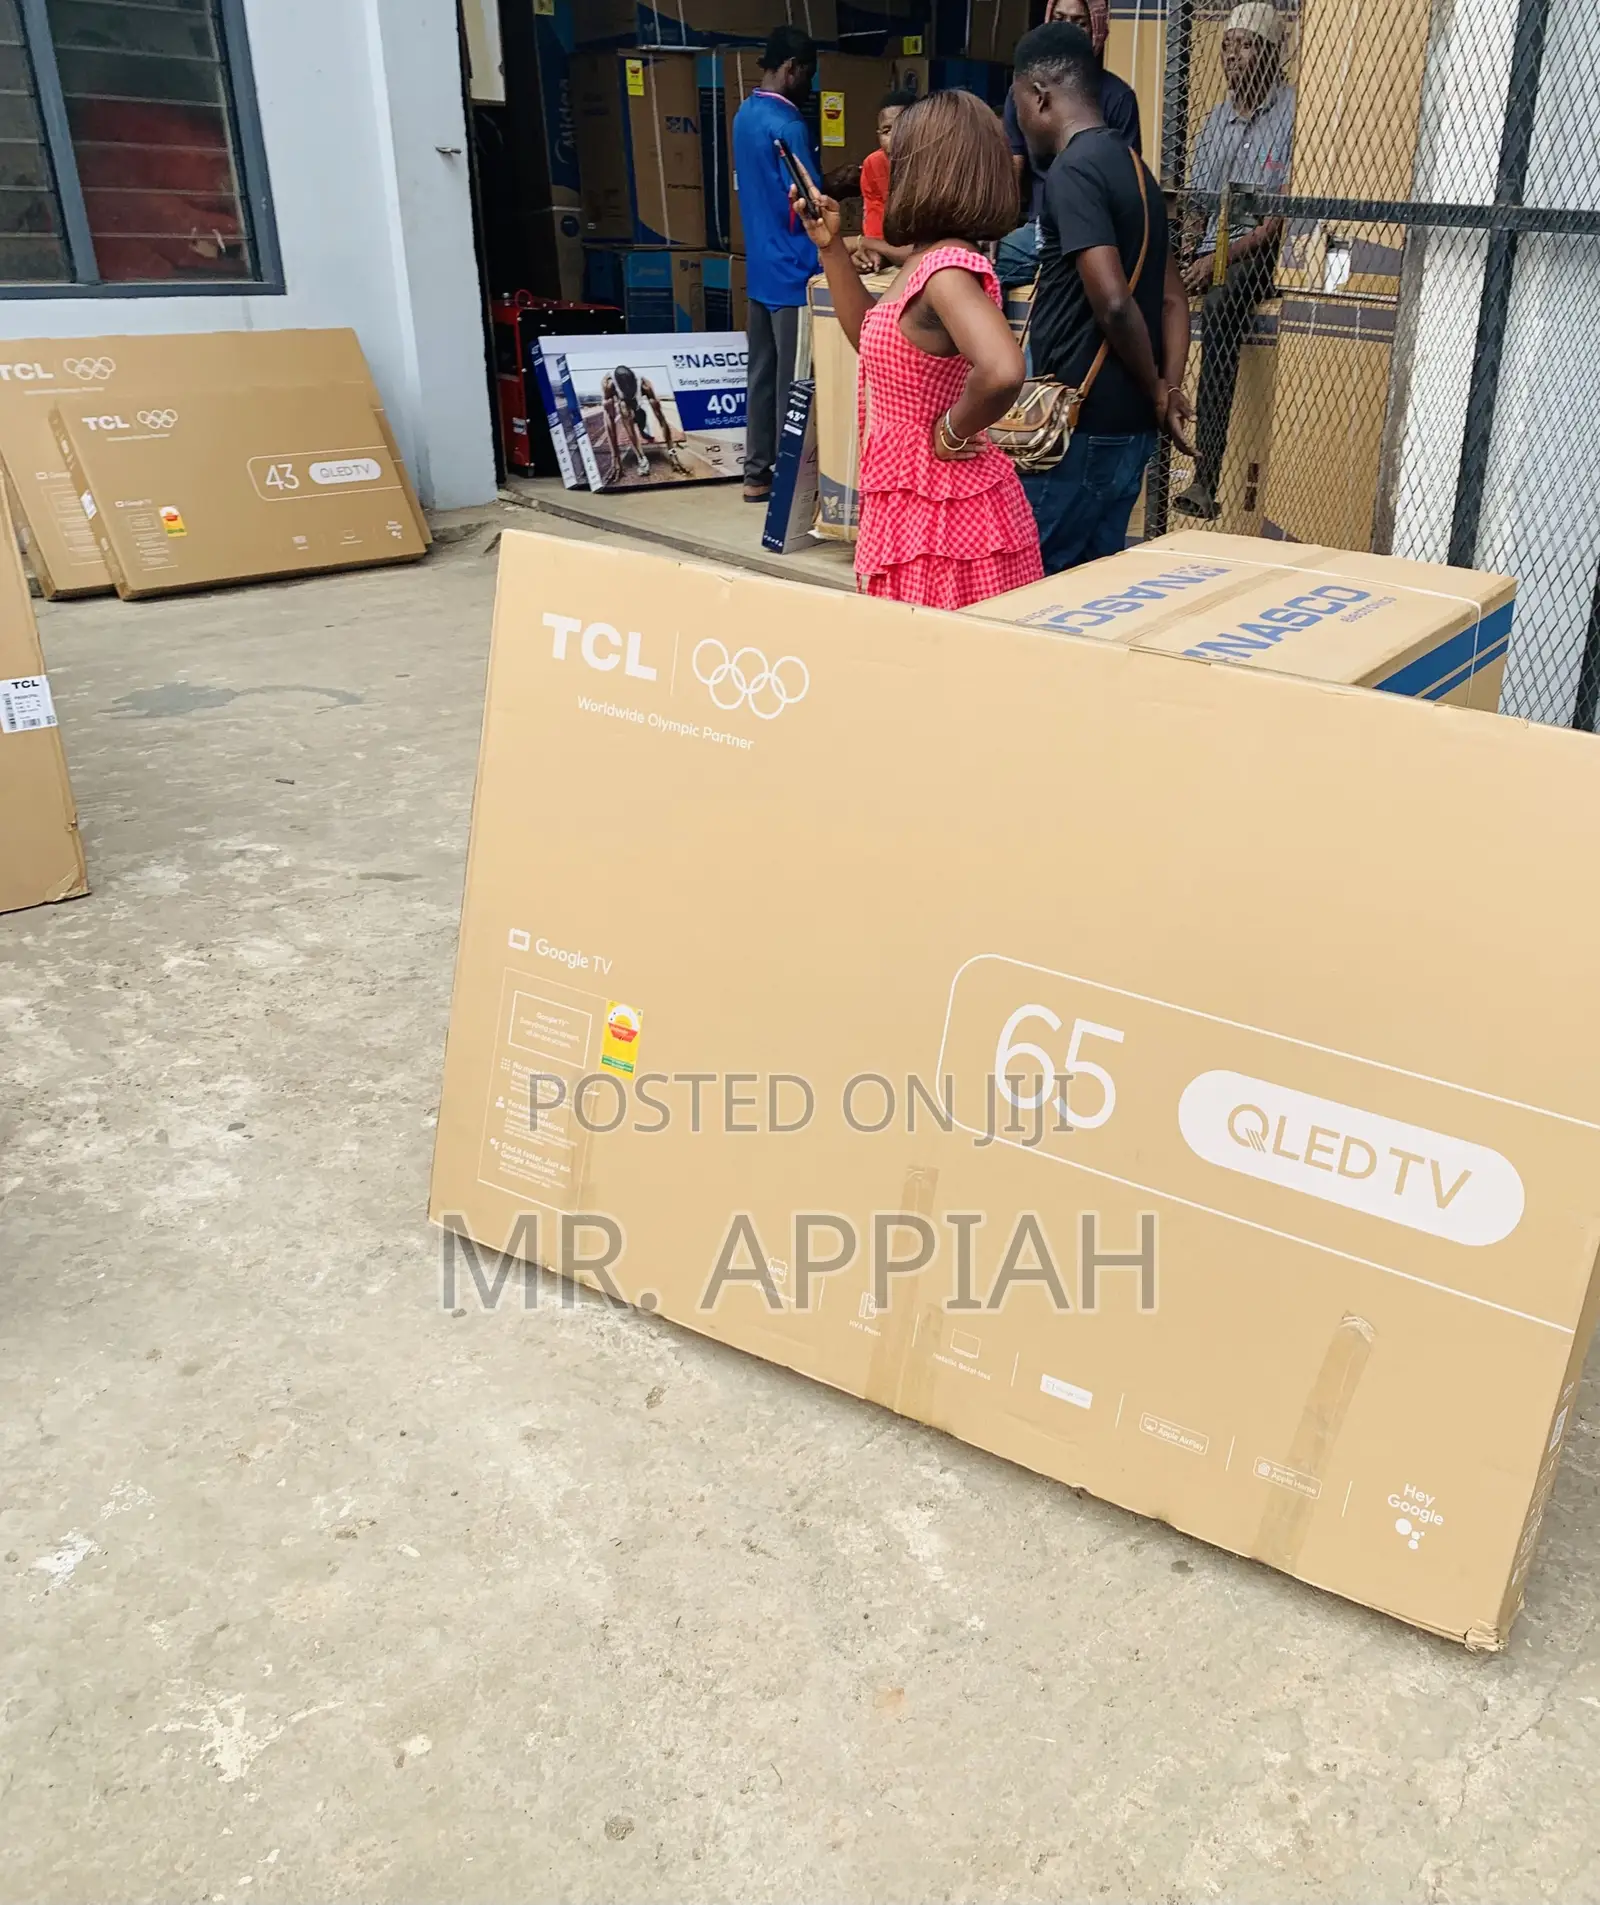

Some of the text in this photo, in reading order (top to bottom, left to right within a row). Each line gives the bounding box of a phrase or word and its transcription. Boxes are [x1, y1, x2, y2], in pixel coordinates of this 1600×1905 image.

[0, 362, 54, 381] TCL
[687, 352, 748, 368] NASCO
[678, 378, 698, 387] Bring
[722, 376, 748, 386] Happin
[707, 393, 745, 414] 40"
[82, 416, 130, 431] TCL
[266, 463, 371, 490] 43 QLED TV
[1015, 604, 1064, 623] electro
[1196, 586, 1370, 659] NASCO
[1340, 596, 1397, 624] electronics
[542, 612, 657, 681] TCL
[11, 680, 40, 689] TCL
[578, 695, 754, 750] Worldwide Olympic Partner
[535, 938, 613, 974] Google TV
[994, 1004, 1473, 1210] 65 QLED TV
[1157, 1426, 1179, 1442] Apple
[1179, 1433, 1205, 1452] AirPlay
[1403, 1483, 1436, 1507] Hey
[1387, 1493, 1444, 1525] Google
